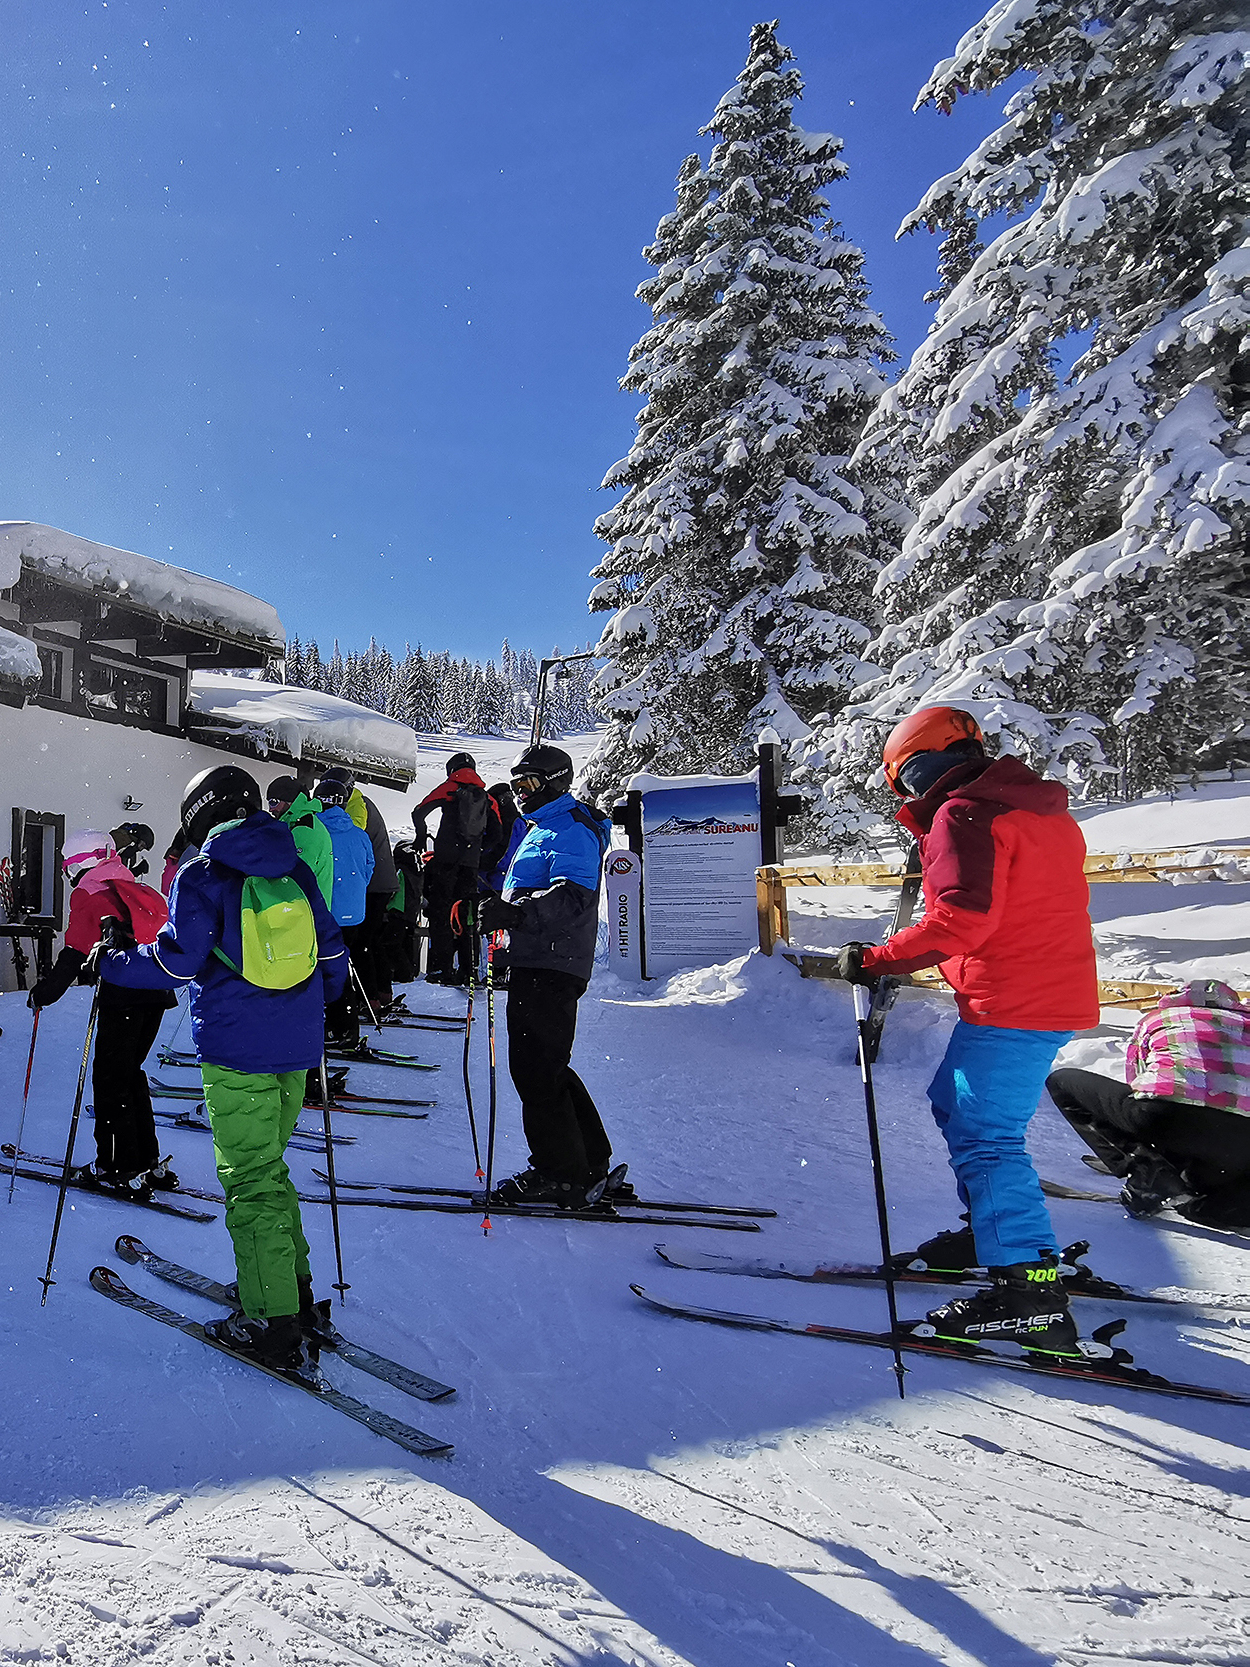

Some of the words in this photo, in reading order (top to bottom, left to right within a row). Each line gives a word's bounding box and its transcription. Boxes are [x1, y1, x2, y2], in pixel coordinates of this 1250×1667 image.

[618, 894, 628, 927] RADIO
[619, 929, 628, 946] HIT
[964, 1313, 1064, 1335] FISCHER
